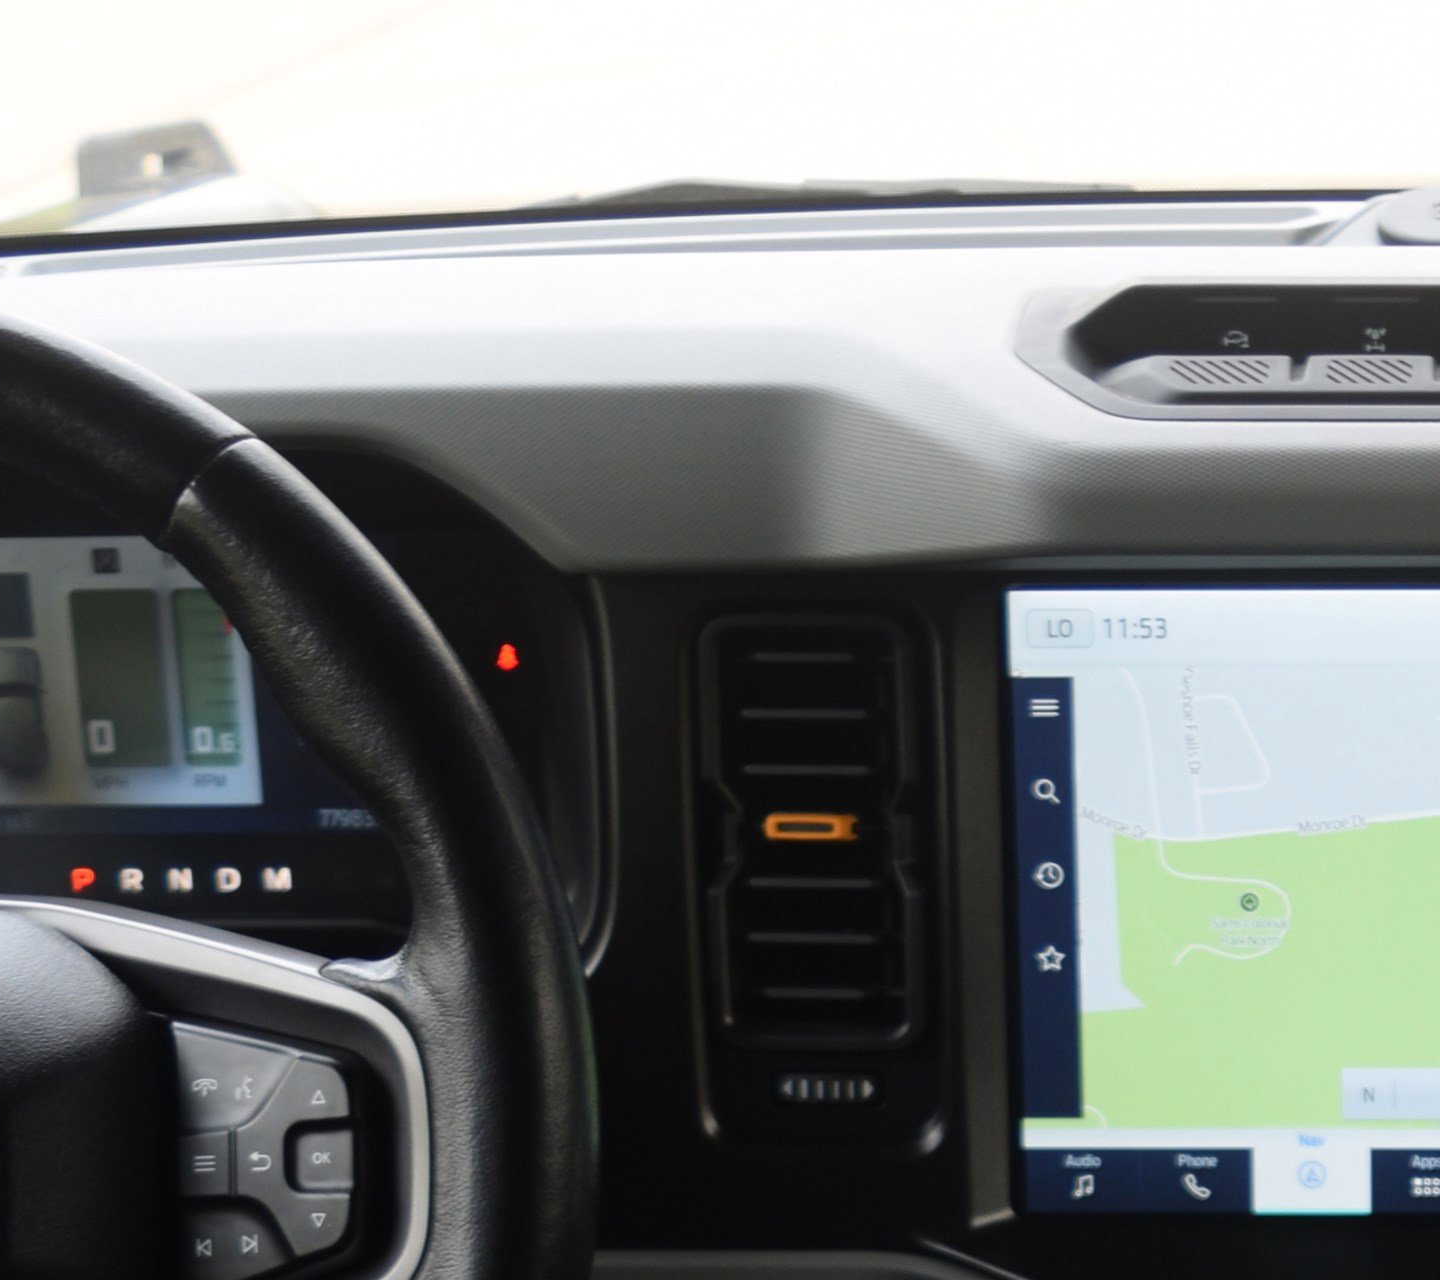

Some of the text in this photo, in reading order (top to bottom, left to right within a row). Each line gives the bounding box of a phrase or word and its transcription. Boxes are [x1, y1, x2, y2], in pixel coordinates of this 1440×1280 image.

[1046, 616, 1168, 640] LO 11:53
[1298, 814, 1367, 833] Monroe Dr
[70, 866, 293, 893] P R N D M
[1362, 1087, 1377, 1103] N
[1298, 1134, 1325, 1147] Nav
[312, 1152, 331, 1164] OK
[1065, 1154, 1102, 1169] Audio
[1177, 1153, 1219, 1169] Phone
